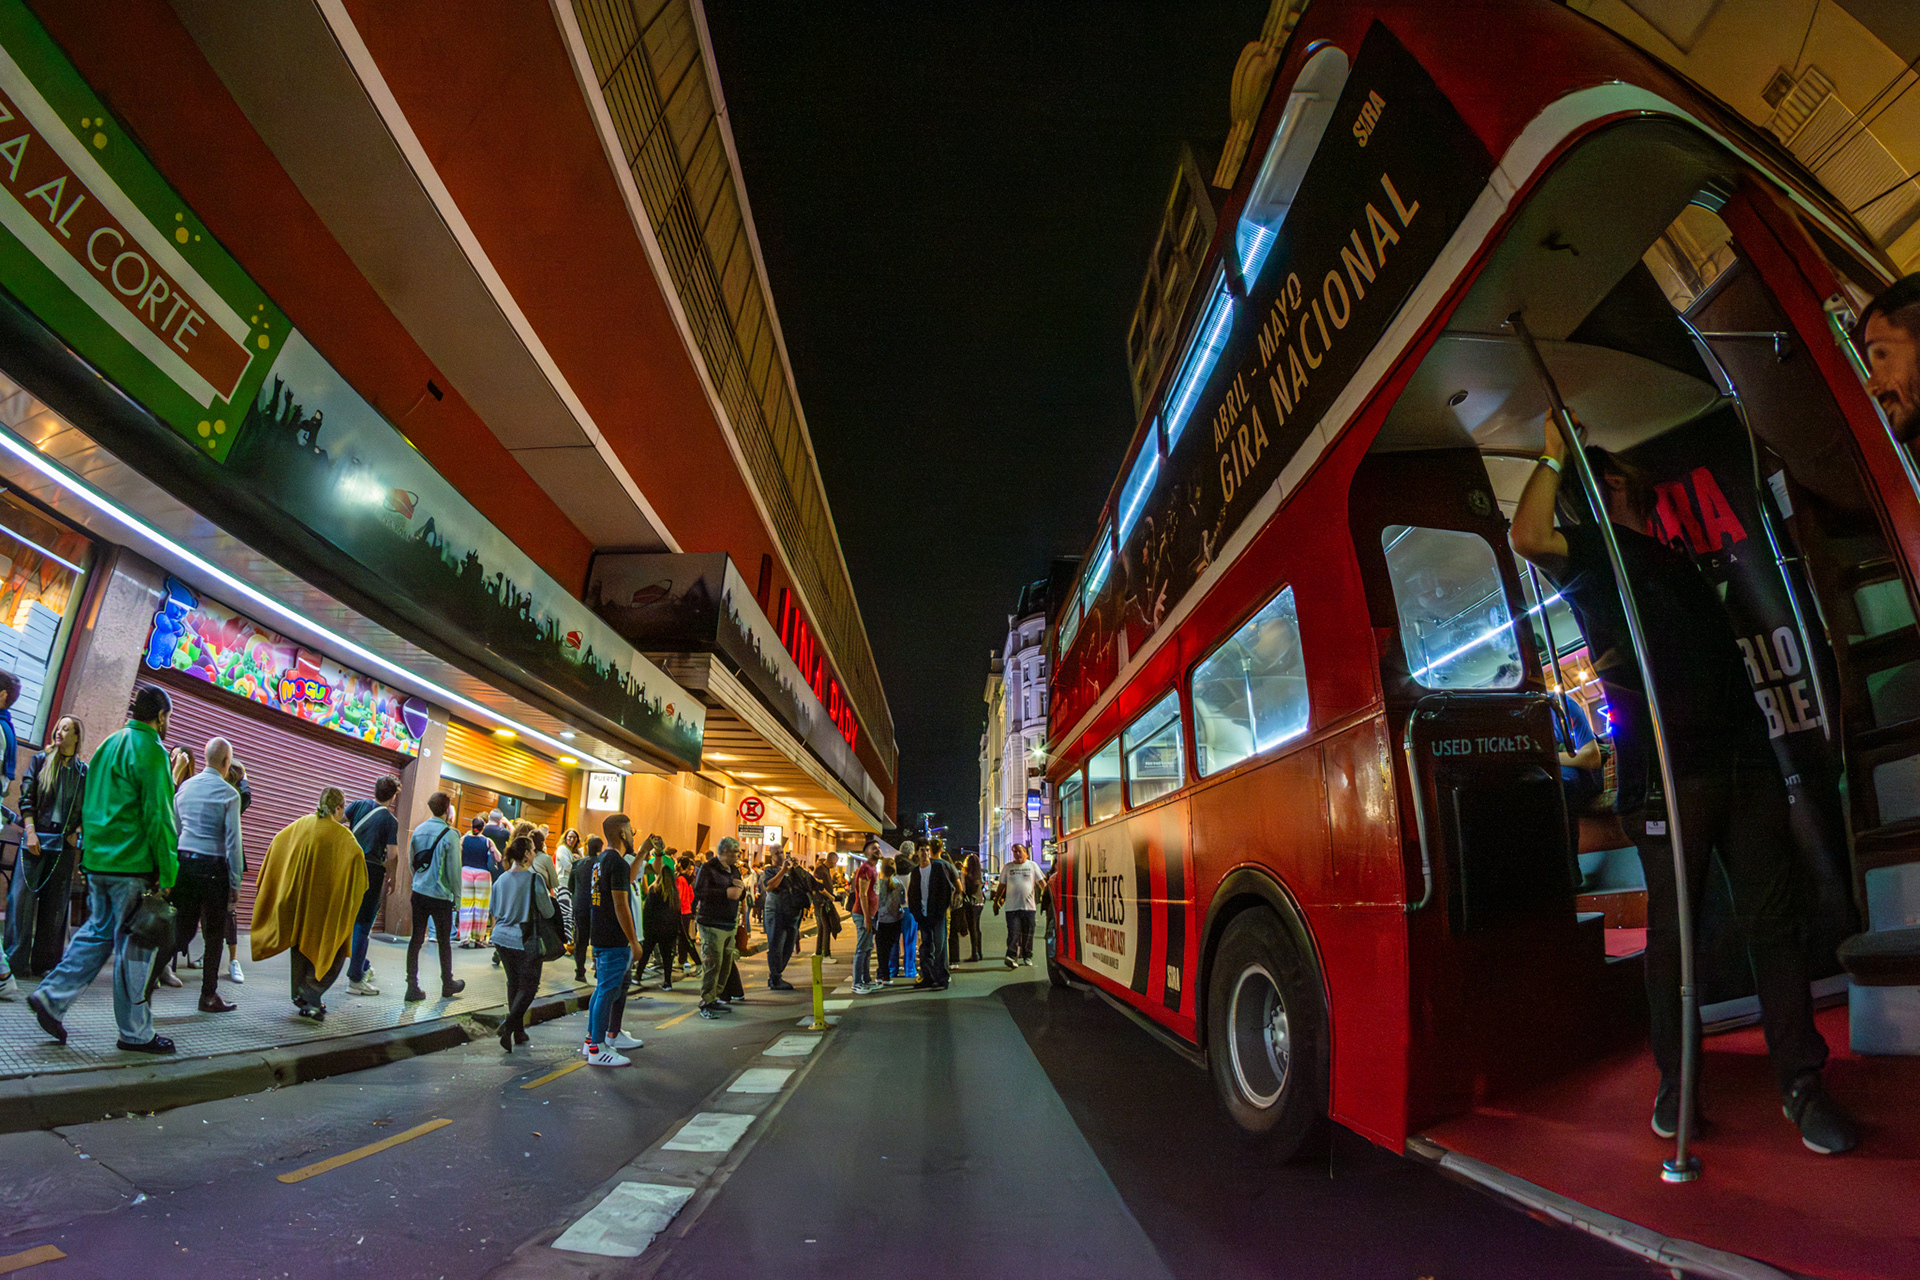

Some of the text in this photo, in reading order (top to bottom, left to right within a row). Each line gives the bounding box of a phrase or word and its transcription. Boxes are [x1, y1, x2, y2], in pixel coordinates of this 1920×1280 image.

[1352, 89, 1387, 148] SIRA
[24, 175, 86, 239] AL
[87, 227, 205, 353] CORTE
[1213, 371, 1250, 453] ABRIL
[1257, 271, 1302, 368] MAYO
[1219, 172, 1420, 502] GIRA NACIONAL
[1646, 465, 1748, 554] RA
[1735, 626, 1802, 684] RLO
[281, 679, 332, 704] MOGUL
[1431, 735, 1530, 756] USED TICKETS
[594, 774, 618, 782] PUERTA
[599, 785, 609, 803] 4
[769, 832, 776, 842] 3
[1085, 868, 1125, 926] BEATLES
